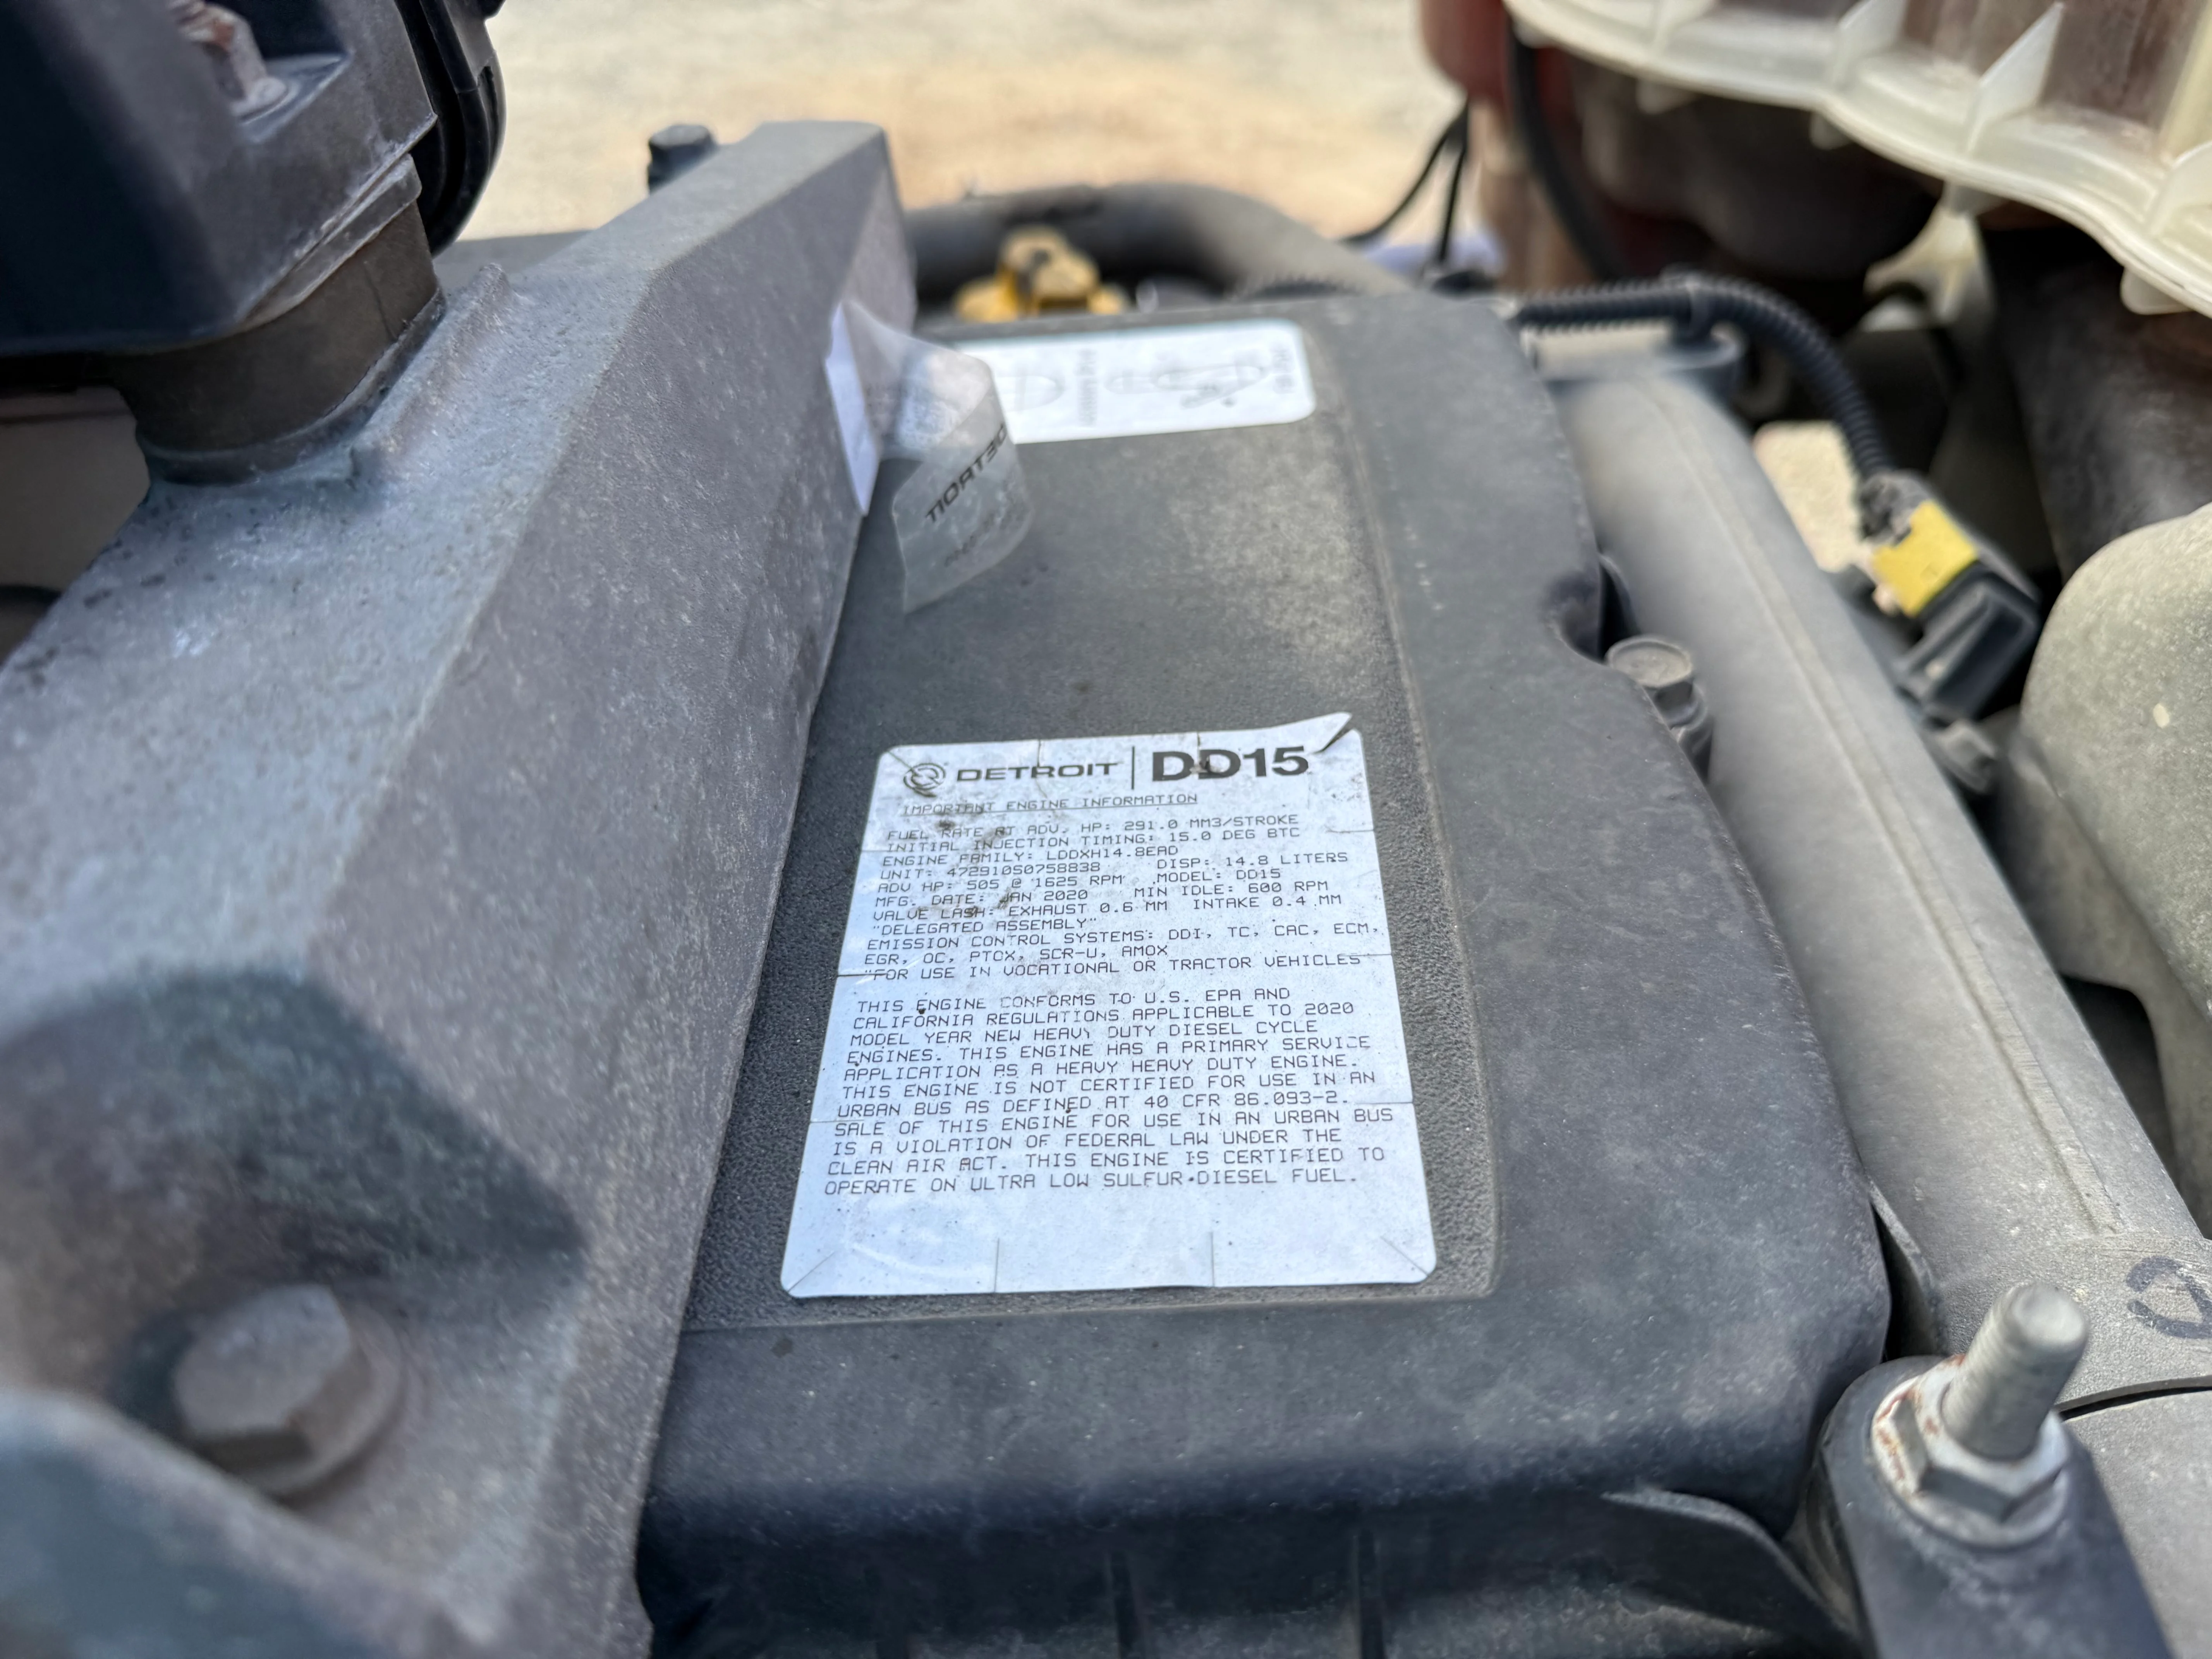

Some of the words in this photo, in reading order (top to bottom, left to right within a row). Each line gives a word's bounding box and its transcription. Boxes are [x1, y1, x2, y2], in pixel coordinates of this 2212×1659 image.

[957, 763, 1118, 781] DETROIT
[1152, 745, 1309, 781] DD15
[903, 801, 995, 814] IMPORTANT
[1006, 799, 1068, 809] ENGINE
[1084, 794, 1197, 806] INFORMATION
[887, 830, 928, 840] FUEL
[941, 827, 983, 838] RATE
[994, 826, 1015, 835] AT
[1027, 824, 1068, 834] ADV.
[1081, 822, 1109, 832] HP:
[1124, 819, 1177, 830] 291.0
[1190, 814, 1297, 828] MM3/STROKE
[887, 842, 958, 852] INITIAL
[975, 837, 1068, 850] INJECTION
[1082, 833, 1152, 845] TIMING:
[1170, 831, 1210, 842] 15.0
[1222, 829, 1254, 840] DEG
[1267, 827, 1298, 838] BTC
[880, 869, 931, 879] UNIT:
[1157, 857, 1210, 869] DISP:
[1226, 855, 1268, 866] 14.8
[1280, 852, 1347, 864] LITERS
[883, 855, 947, 866] ENGINE
[959, 852, 1032, 863] FAMILY:
[1047, 845, 1177, 860] LDDXH14.8EAD
[875, 896, 915, 907] MFG.
[931, 893, 983, 905] DATE:
[998, 891, 1032, 903] JAN
[1044, 889, 1087, 901] 2020
[1134, 886, 1166, 897] MIN
[1182, 884, 1234, 895] IDLE:
[1248, 882, 1282, 893] 600
[1294, 880, 1328, 891] RPM
[878, 883, 911, 893] ADV
[922, 881, 952, 891] HP:
[967, 879, 999, 890] 505
[1011, 878, 1022, 888] @
[1034, 876, 1077, 887] 1625
[1089, 874, 1121, 885] RPM
[1157, 871, 1222, 882] MODEL:
[1236, 868, 1281, 879] DD15
[873, 909, 928, 921] VALVE
[941, 907, 993, 919] LASH:
[1008, 903, 1087, 916] EXHAUST
[1099, 902, 1132, 913] 0.6
[1143, 900, 1166, 911] MM
[1194, 896, 1260, 909] INTAKE
[1272, 895, 1306, 907] 0.4
[1319, 894, 1341, 904] MM
[867, 937, 959, 950] EMISSION
[1064, 930, 1152, 943] SYSTEMS:
[1168, 928, 1211, 940] DDI,
[1227, 926, 1258, 937] TC,
[1274, 924, 1318, 936] CAC,
[1333, 922, 1377, 934] ECM,
[874, 921, 983, 935] "DELEGATED
[996, 918, 1096, 931] ASSEMBLY"
[864, 953, 907, 965] EGR,
[923, 952, 953, 963] OC,
[1040, 947, 1105, 960] SCR-U,
[1121, 945, 1167, 957] AMOX
[921, 967, 955, 979] USE
[970, 966, 990, 977] IN
[1003, 962, 1119, 976] VOCATIONAL
[1133, 960, 1155, 972] OR
[1169, 957, 1250, 970] TRACTOR
[858, 1000, 903, 1012] THIS
[916, 998, 986, 1011] ENGINE
[1109, 992, 1131, 1005] TO
[1144, 991, 1190, 1003] U.S.
[1205, 989, 1242, 1001] EPA
[1254, 987, 1290, 1000] AND
[853, 1014, 973, 1029] CALIFORNIA
[986, 1009, 1118, 1025] REGULATIONS
[1132, 1005, 1254, 1020] APPLICABLE
[1267, 1003, 1291, 1016] TO
[1305, 1002, 1353, 1015] 2020
[850, 1032, 909, 1046] MODEL
[924, 1030, 972, 1044] YEAR
[984, 1029, 1020, 1042] NEW
[1108, 1025, 1155, 1038] DUTY
[1169, 1022, 1241, 1036] DIESEL
[1256, 1020, 1316, 1034] CYCLE
[847, 1048, 941, 1064] ENGINES.
[959, 1046, 1006, 1060] THIS
[1020, 1044, 1093, 1058] ENGINE
[1107, 1042, 1143, 1055] HAS
[1156, 1041, 1168, 1054] A
[1182, 1039, 1267, 1053] PRIMARY
[844, 1065, 980, 1081] APPLICATION
[993, 1063, 1018, 1077] AS
[1031, 1062, 1042, 1075] A
[1056, 1061, 1118, 1074] HEAVY
[1132, 1058, 1192, 1072] HEAVY
[1207, 1056, 1255, 1070] DUTY
[1271, 1054, 1356, 1068] ENGINE.
[843, 1085, 891, 1099] THIS
[903, 1082, 978, 1097] ENGINE
[996, 1081, 1016, 1094] IS
[1030, 1079, 1066, 1093] NOT
[1080, 1076, 1193, 1091] CERTIFIED
[1207, 1074, 1244, 1088] FOR
[1259, 1073, 1295, 1087] USE
[1313, 1072, 1334, 1085] IN
[1350, 1071, 1373, 1084] AN
[838, 1103, 900, 1117] URBAN
[914, 1101, 951, 1115] BUS
[965, 1100, 989, 1113] AS
[1003, 1096, 1091, 1112] DEFINED
[1105, 1096, 1129, 1109] AT
[1144, 1094, 1168, 1108] 40
[1182, 1093, 1219, 1107] CFR
[1234, 1090, 1347, 1106] 86.093-2.
[835, 1121, 885, 1136] SALE
[898, 1120, 924, 1134] OF
[939, 1118, 988, 1133] THIS
[1001, 1115, 1077, 1130] ENGINE
[1092, 1114, 1129, 1128] FOR
[1144, 1113, 1181, 1128] USE
[1198, 1112, 1220, 1126] IN
[1235, 1111, 1259, 1125] AN
[1274, 1109, 1338, 1124] URBAN
[1354, 1108, 1391, 1122] BUS
[833, 1141, 857, 1156] IS
[870, 1140, 883, 1154] A
[896, 1136, 1012, 1153] VIOLATION
[1025, 1135, 1050, 1148] OF
[1065, 1133, 1154, 1147] FEDERAL
[1170, 1131, 1207, 1146] LAW
[1223, 1129, 1286, 1144] UNDER
[1302, 1128, 1340, 1142] THE
[828, 1160, 893, 1175] CLEAN
[906, 1158, 945, 1173] AIR
[959, 1156, 1006, 1171] ACT.
[1026, 1154, 1076, 1168] THIS
[1091, 1151, 1168, 1167] ENGINE
[1185, 1151, 1208, 1165] IS
[1223, 1147, 1341, 1164] CERTIFIED
[1358, 1147, 1382, 1161] TO
[824, 1178, 916, 1195] OPERATE
[930, 1178, 956, 1192] ON
[970, 1174, 1035, 1191] ULTRA
[1050, 1173, 1089, 1187] LOW
[1103, 1171, 1182, 1187] SULFUR
[1197, 1169, 1276, 1185] DIESEL
[1292, 1168, 1355, 1182] FUEL.
